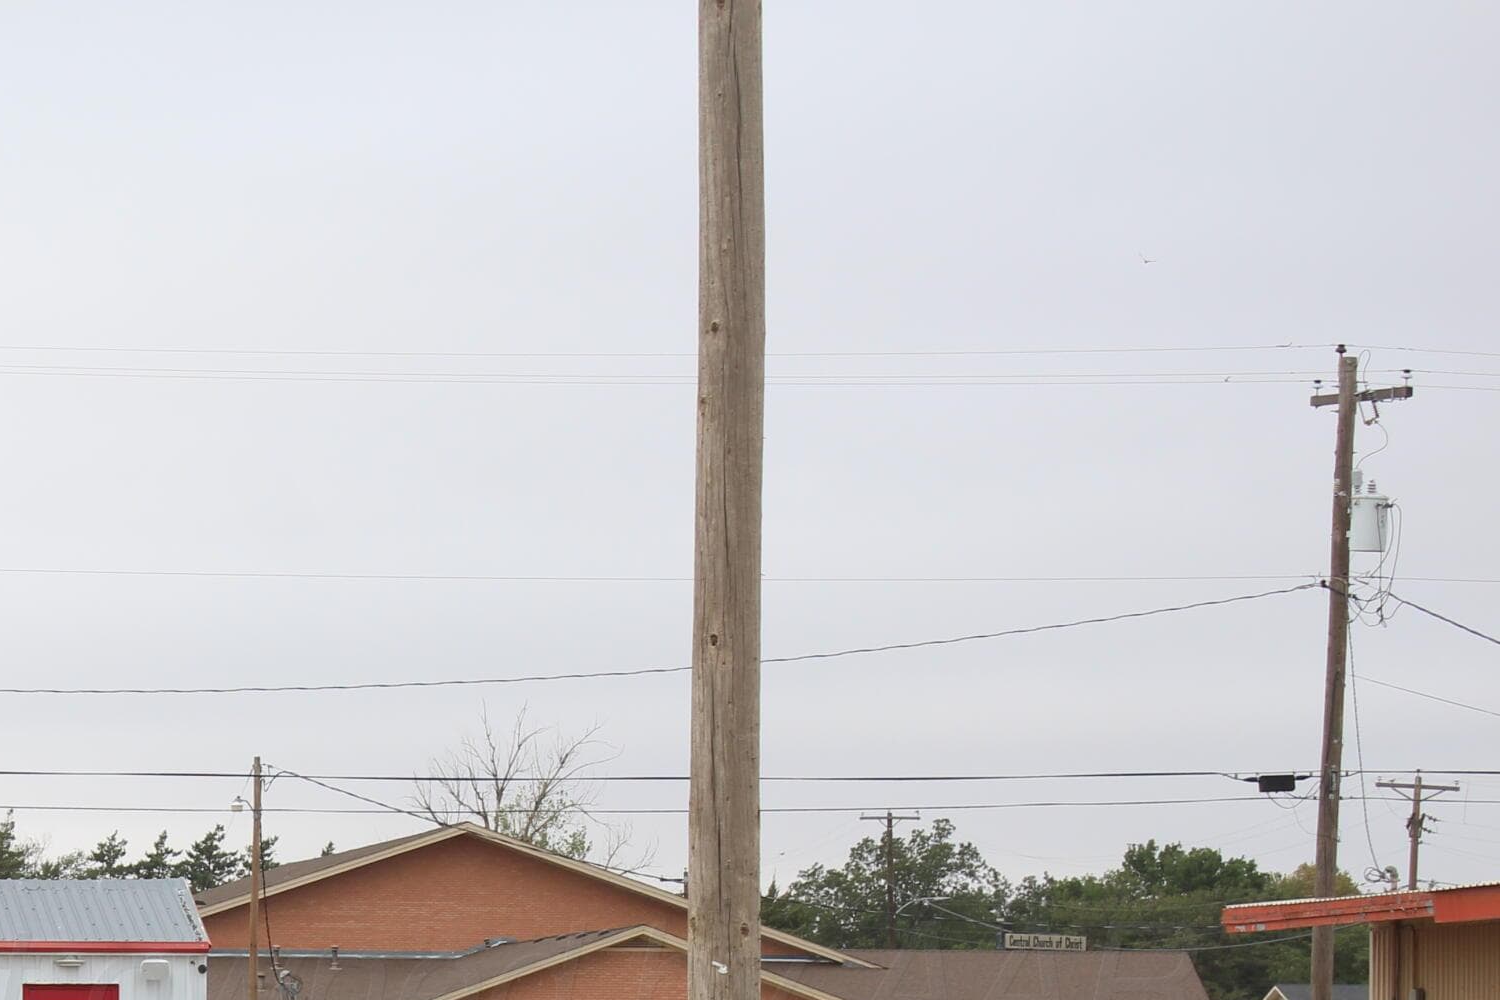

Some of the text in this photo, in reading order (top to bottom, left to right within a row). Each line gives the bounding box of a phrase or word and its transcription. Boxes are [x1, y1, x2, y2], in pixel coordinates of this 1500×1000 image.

[1009, 935, 1083, 950] Central Church of Christ
